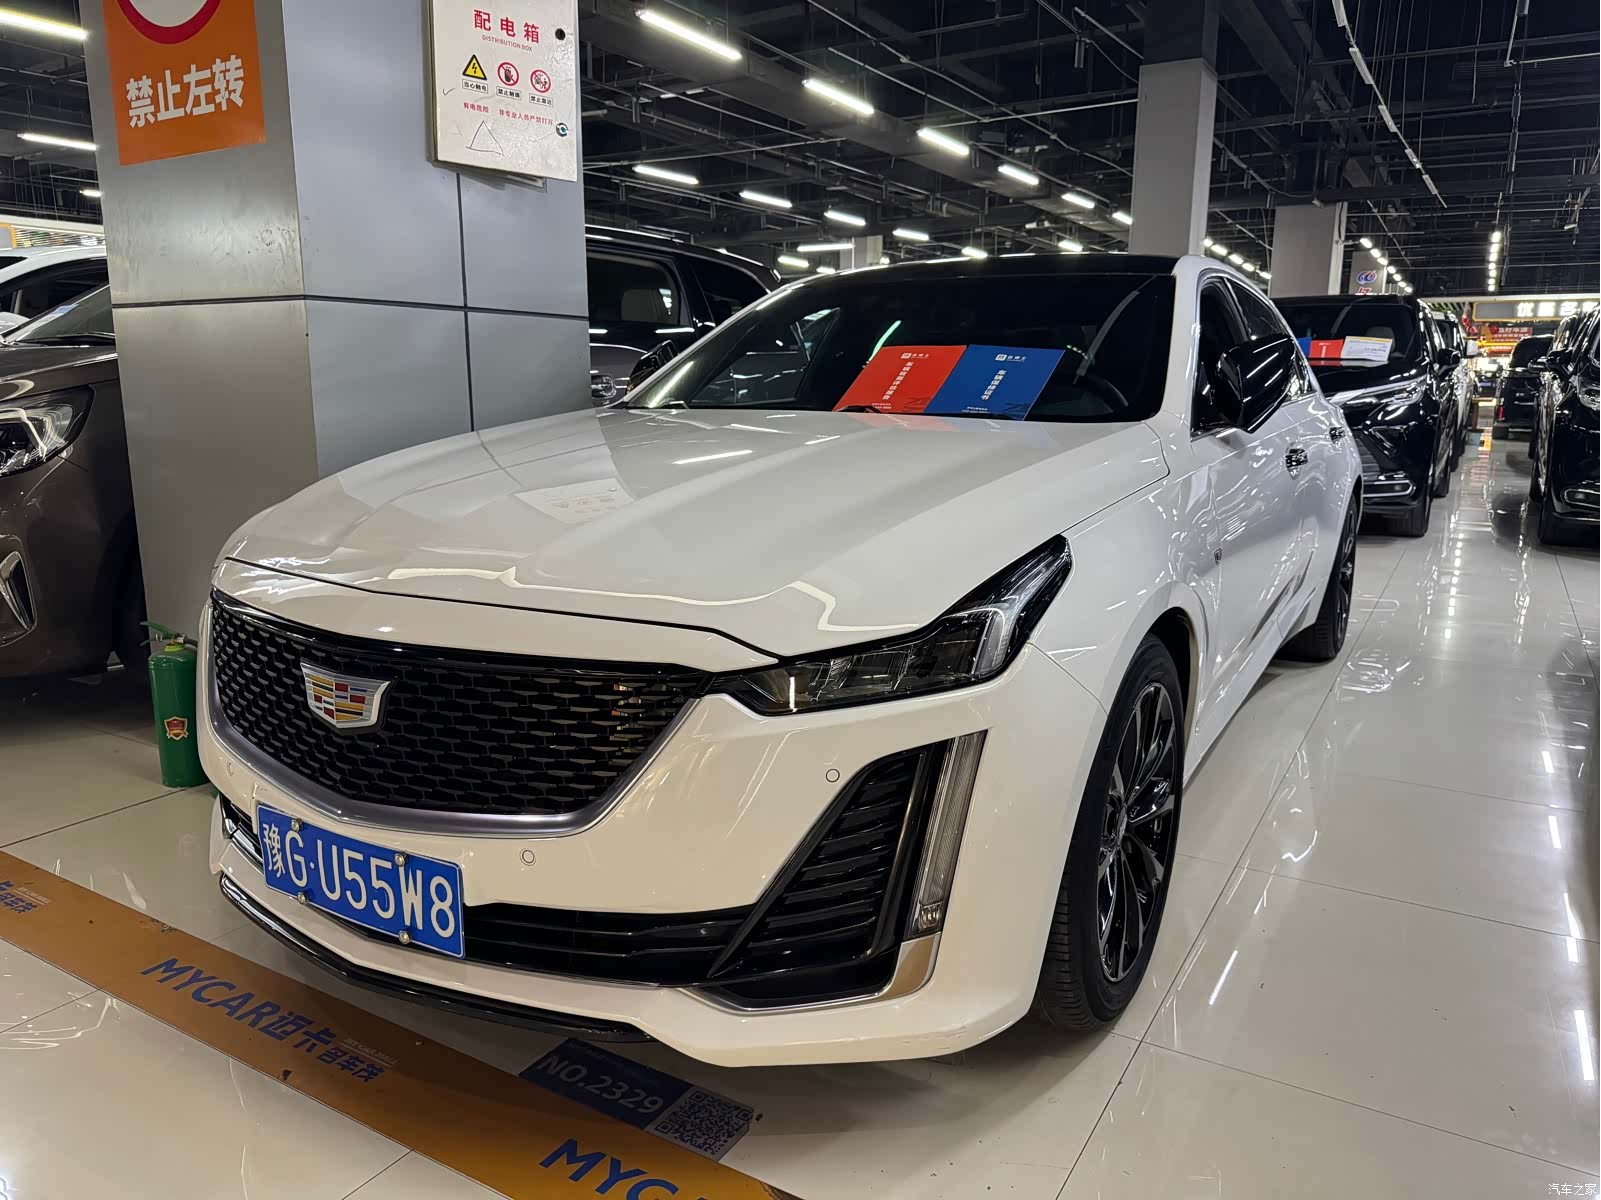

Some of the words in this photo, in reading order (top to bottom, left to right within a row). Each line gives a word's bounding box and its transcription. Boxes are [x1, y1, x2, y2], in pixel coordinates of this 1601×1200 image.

[474, 9, 539, 44] 配电箱
[482, 34, 521, 49] DISTRIBUTION
[521, 44, 533, 52] BOX
[126, 55, 244, 128] 禁止左转
[463, 81, 487, 92] 当心触电
[463, 102, 489, 113] 有电危险
[537, 1055, 664, 1114] NO.2329
[538, 1138, 707, 1200] MYC
